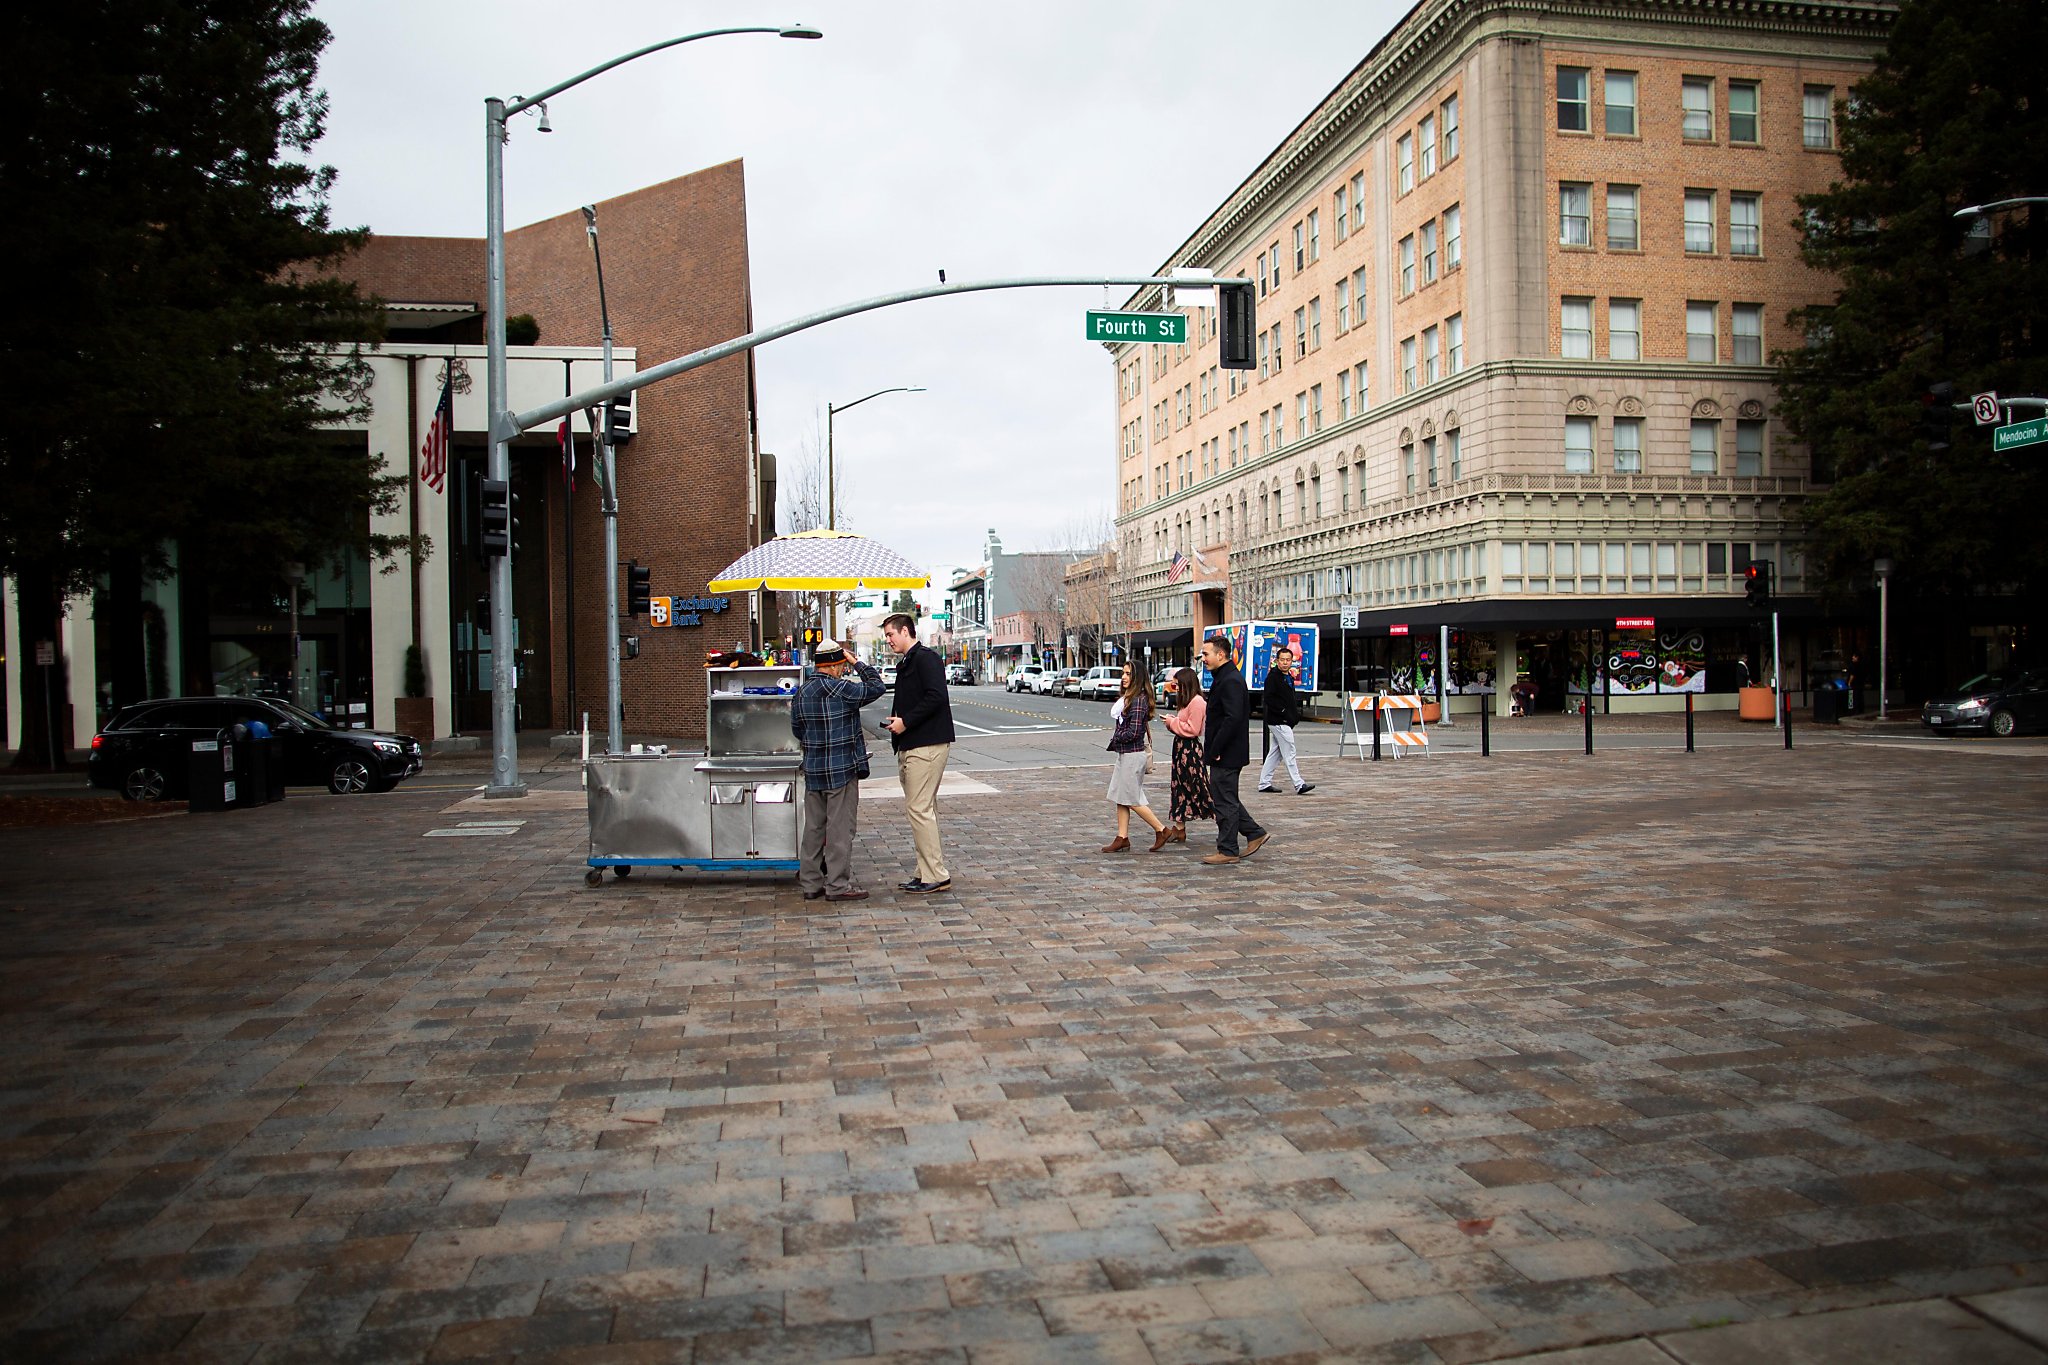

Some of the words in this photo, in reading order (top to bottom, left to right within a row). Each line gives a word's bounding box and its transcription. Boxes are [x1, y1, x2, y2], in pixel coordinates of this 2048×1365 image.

[1096, 318, 1146, 335] Fourth
[1159, 320, 1175, 336] St
[1999, 428, 2038, 444] Mendocino
[672, 595, 728, 613] Exchange
[671, 611, 700, 626] Bank
[1342, 617, 1356, 626] 25
